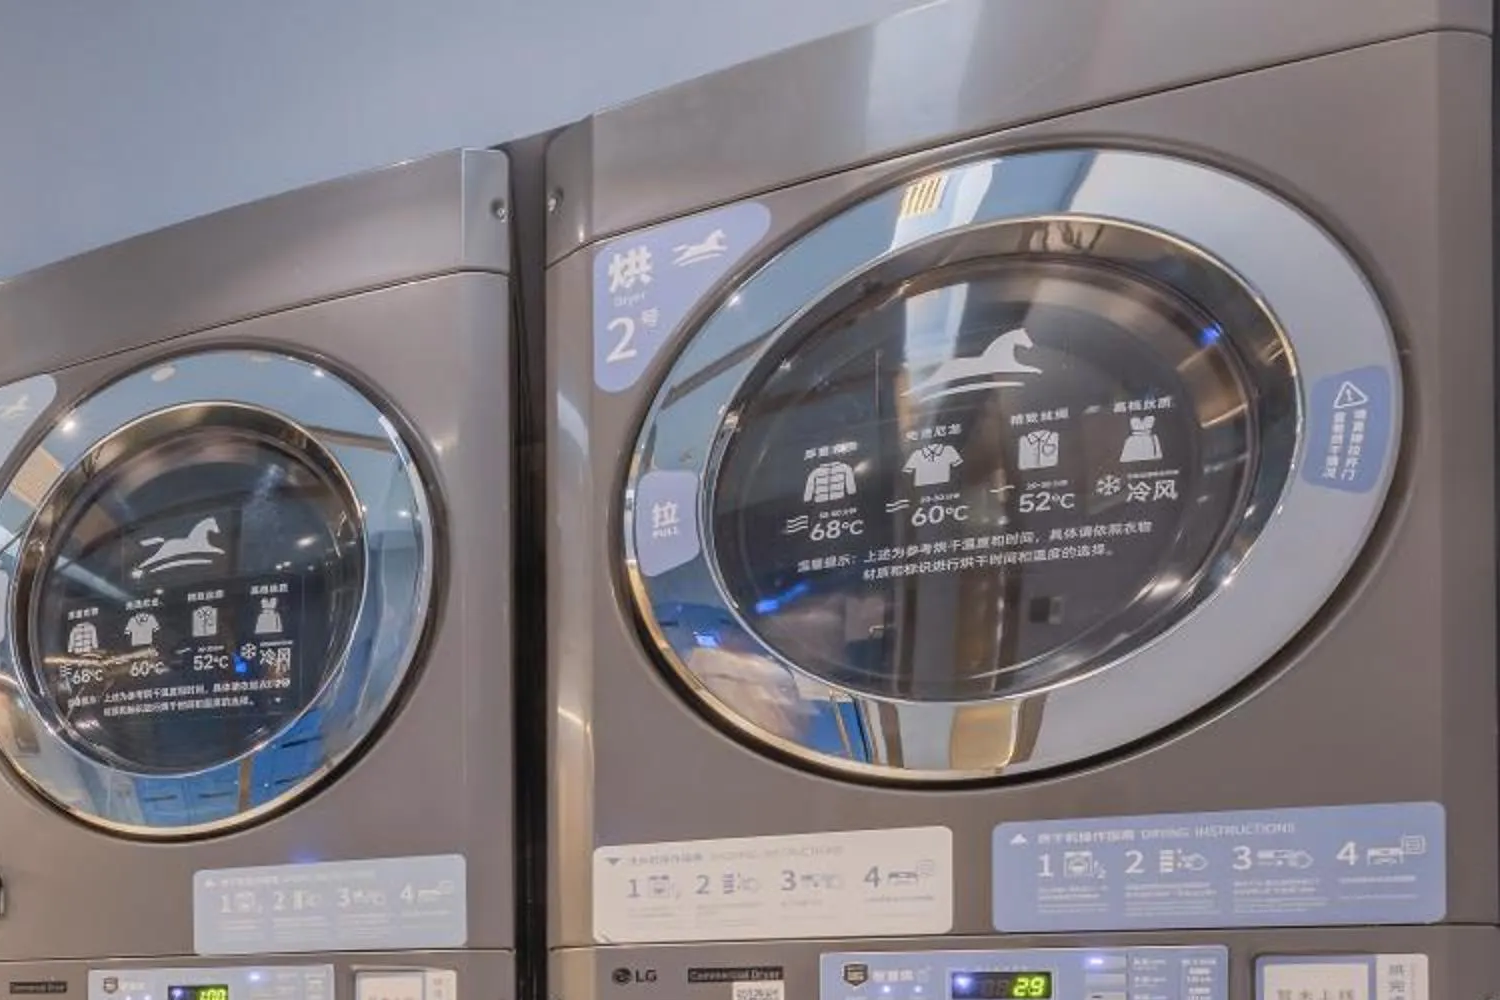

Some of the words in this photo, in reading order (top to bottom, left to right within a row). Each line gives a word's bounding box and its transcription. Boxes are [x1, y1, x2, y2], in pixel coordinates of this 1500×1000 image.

[608, 245, 652, 293] 烘
[1127, 479, 1179, 502] 冷风
[1038, 855, 1053, 878] 1
[1124, 850, 1144, 875] 2
[1232, 846, 1252, 871] 3
[1336, 841, 1356, 866] 4
[273, 891, 286, 911] 2
[337, 888, 350, 908] 3
[400, 882, 413, 901] 4
[627, 877, 641, 898] 1
[695, 875, 710, 896] 2
[781, 870, 797, 892] 3
[863, 866, 880, 889] 4
[1011, 976, 1047, 998] 29
